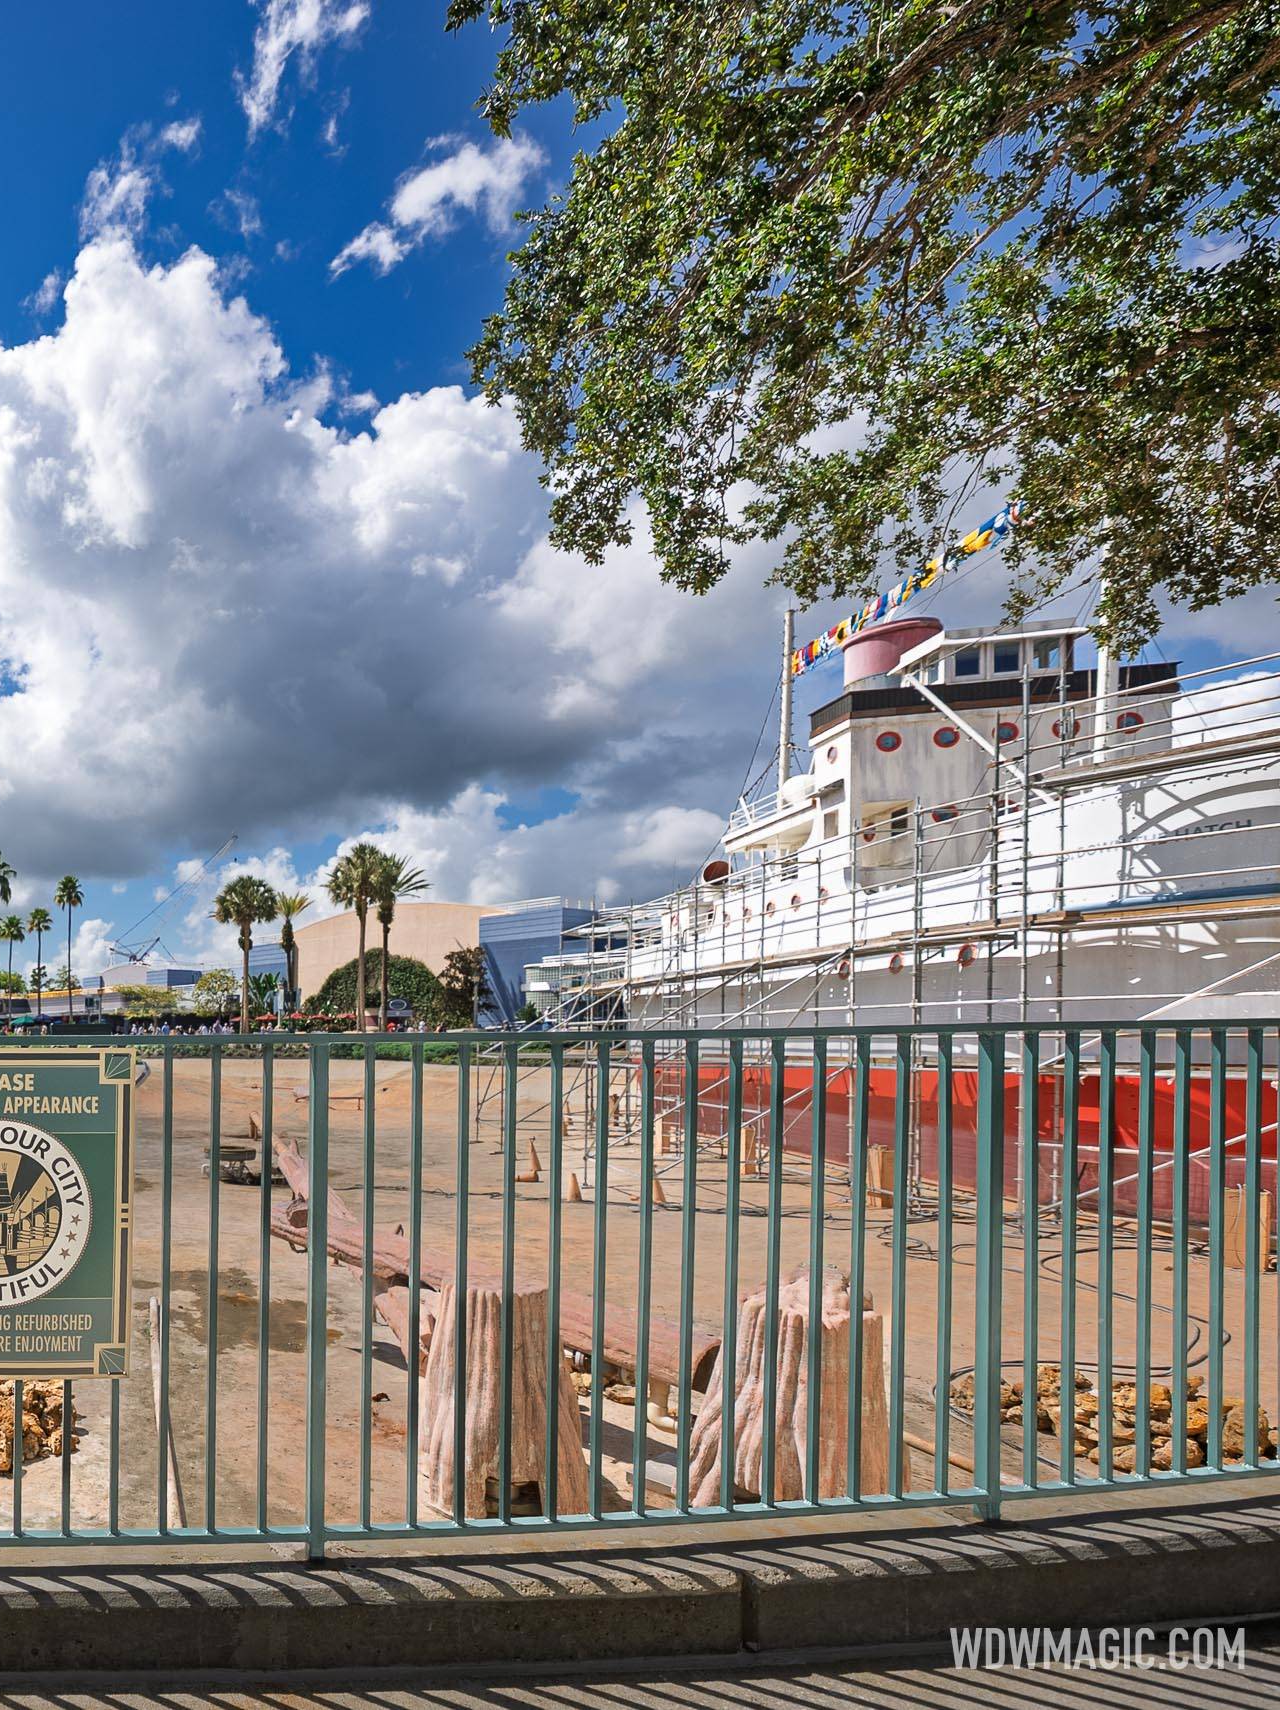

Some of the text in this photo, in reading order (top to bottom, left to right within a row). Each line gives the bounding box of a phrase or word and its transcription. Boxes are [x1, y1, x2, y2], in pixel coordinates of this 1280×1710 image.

[4, 1096, 99, 1114] APPEARANCE
[0, 1126, 51, 1160] OUR
[51, 1157, 85, 1207] CITY
[15, 1314, 93, 1331] REFURBISHED
[15, 1335, 82, 1352] ENJOYMENT
